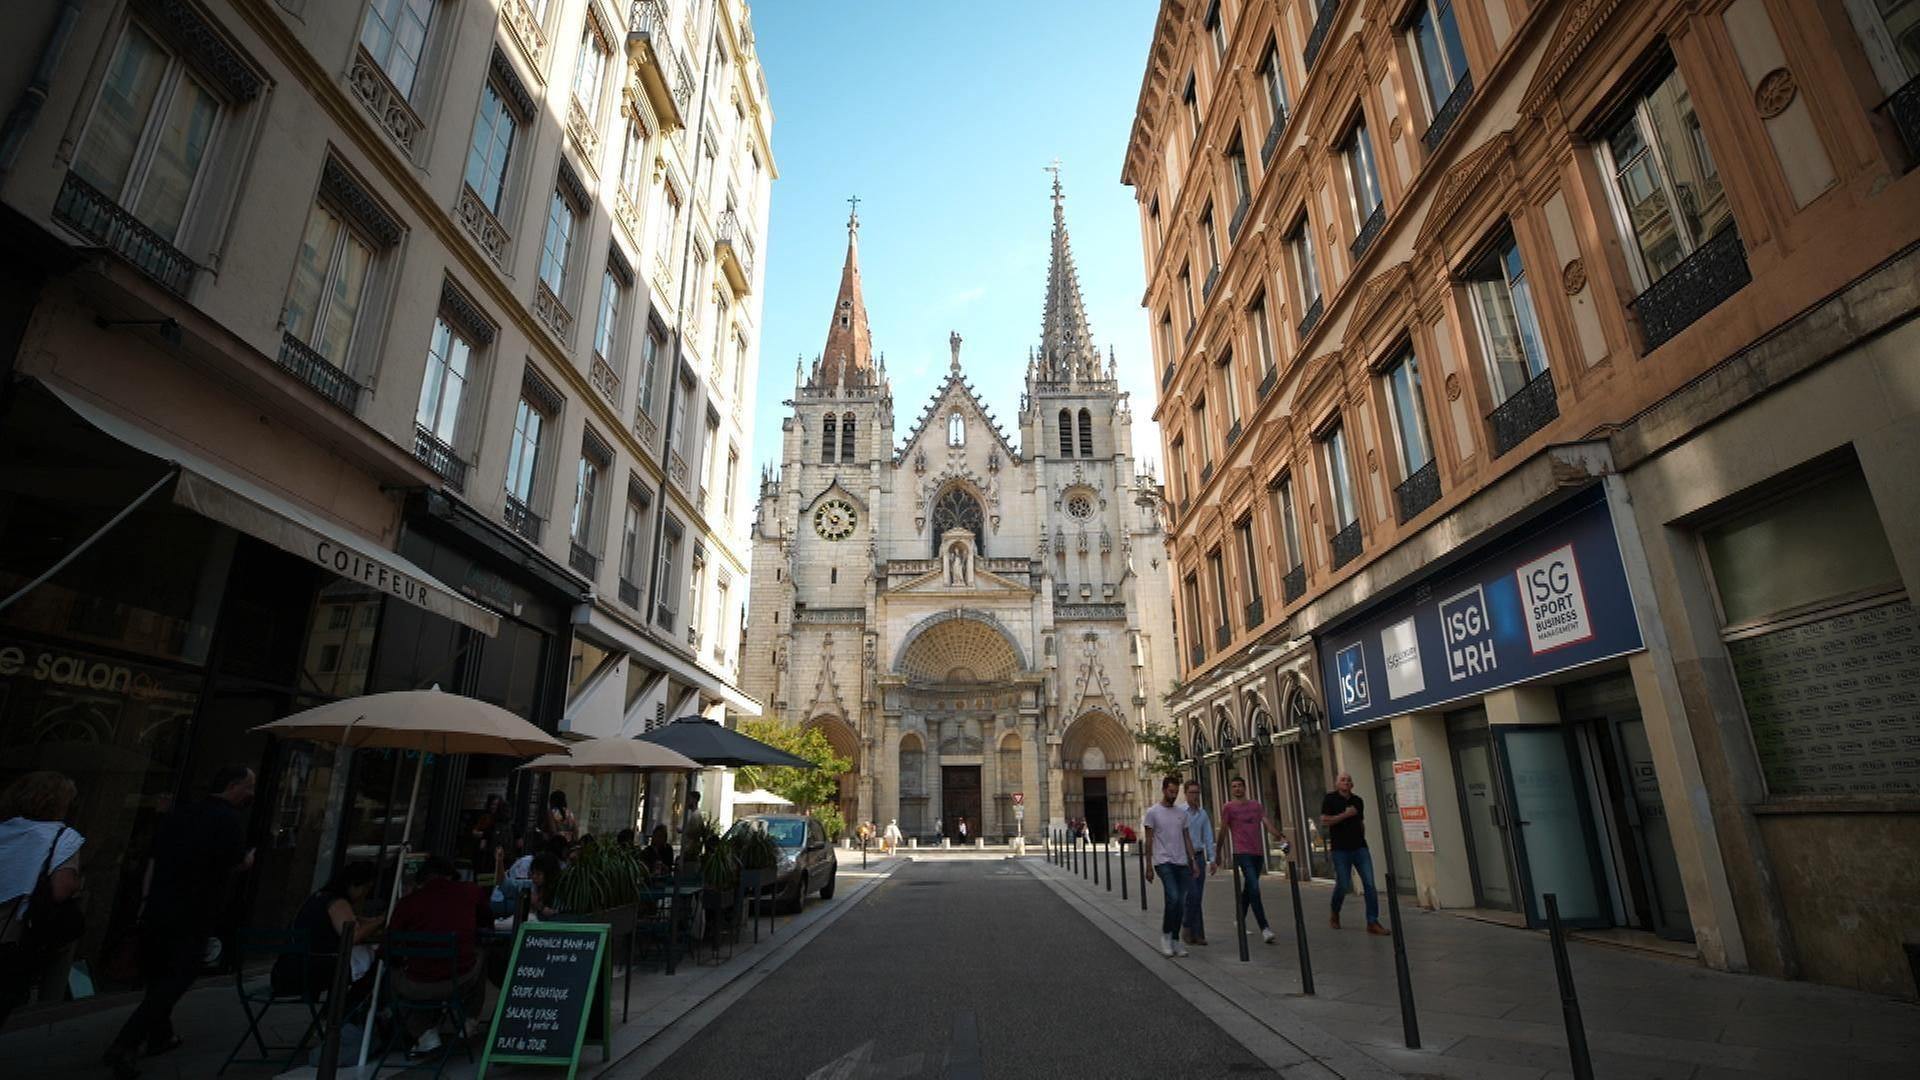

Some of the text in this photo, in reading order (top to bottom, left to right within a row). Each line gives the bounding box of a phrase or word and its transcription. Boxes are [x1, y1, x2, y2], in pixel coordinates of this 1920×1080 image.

[317, 543, 427, 606] COIFFEUR
[1526, 561, 1569, 605] ISG
[1533, 593, 1573, 621] SPORT
[1447, 606, 1481, 644] ISG
[1536, 610, 1578, 632] BUSINESS
[1538, 621, 1580, 640] MANAGEMENT
[1342, 669, 1366, 704] ISG
[525, 935, 561, 949] SANDWICH
[517, 966, 546, 978] BOBUN
[511, 985, 569, 1002] SOUPE ASIATIQUE
[505, 1006, 534, 1019] SALADE
[497, 1037, 517, 1049] PLAT
